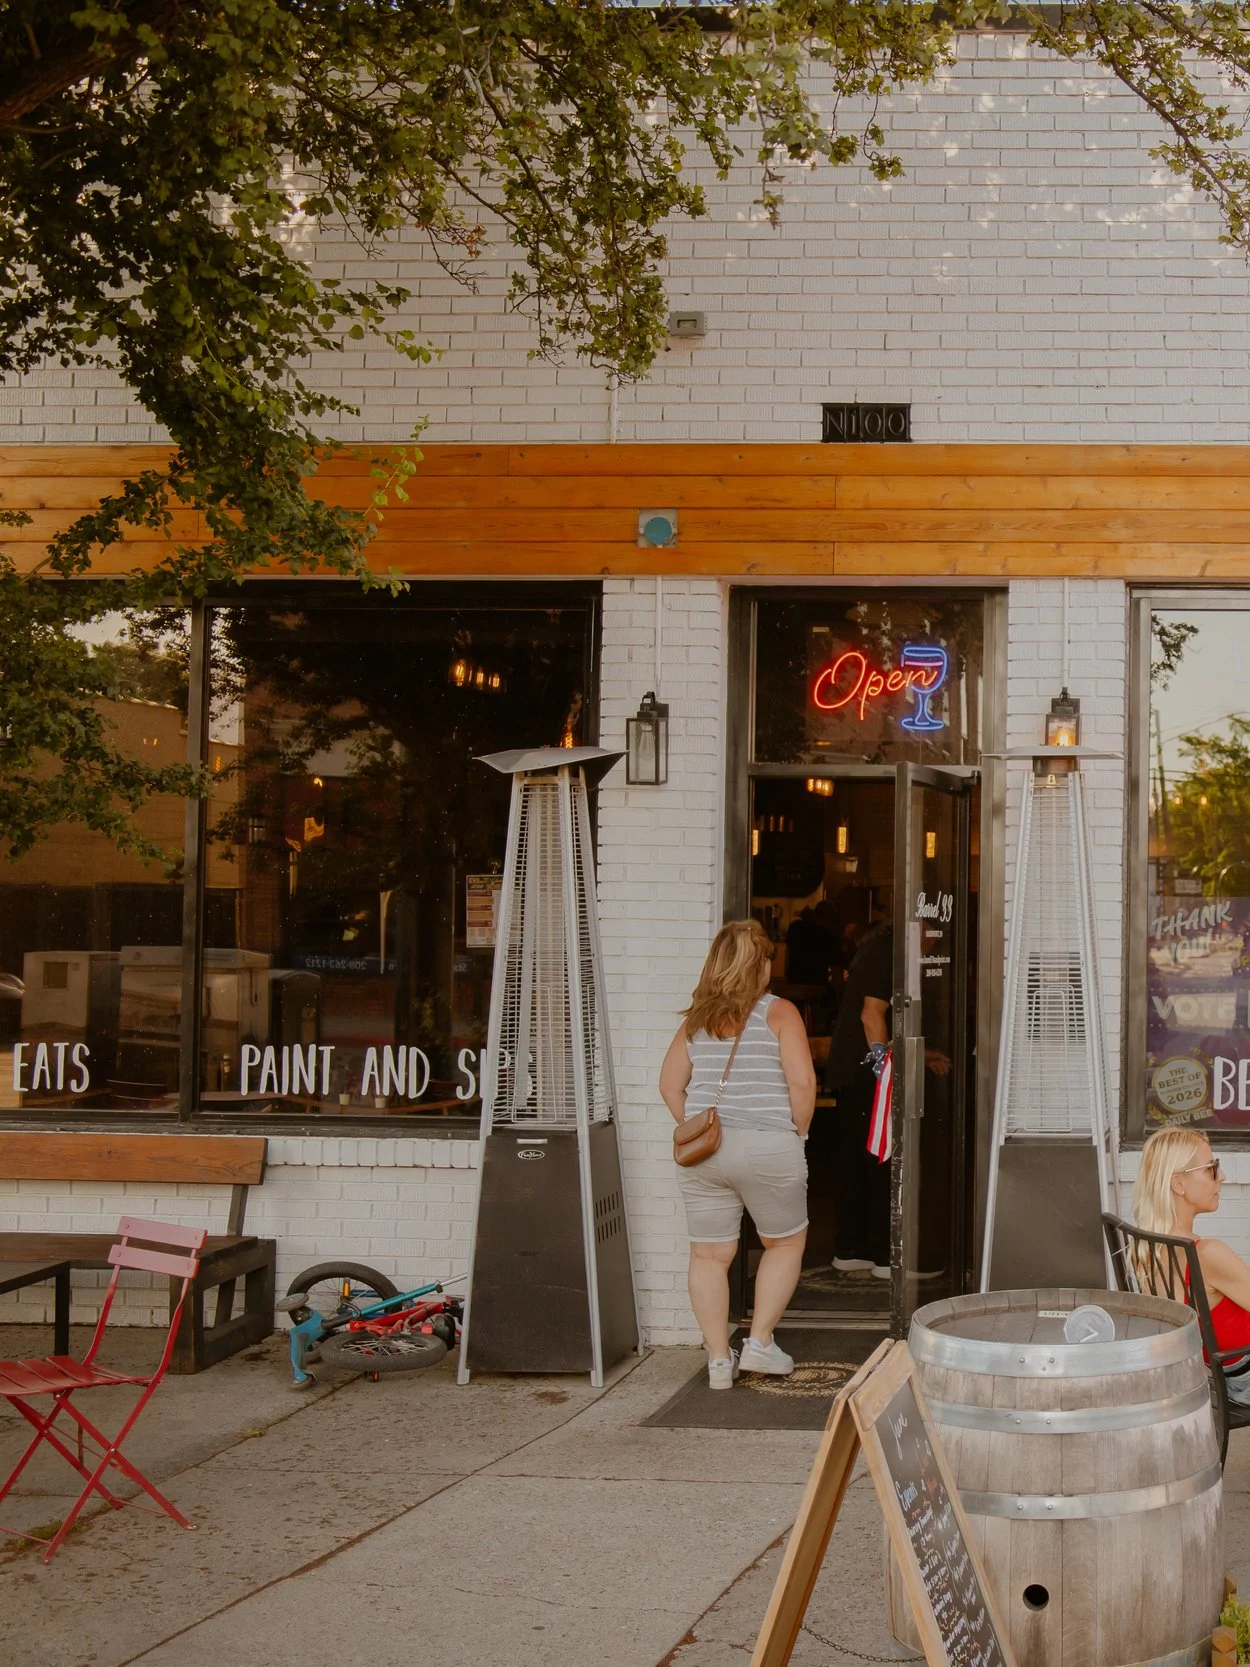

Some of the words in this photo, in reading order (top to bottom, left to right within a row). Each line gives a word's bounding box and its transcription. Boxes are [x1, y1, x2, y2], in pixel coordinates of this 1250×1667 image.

[812, 651, 939, 721] Open
[915, 891, 942, 918] Barrel
[939, 893, 954, 922] 33
[1151, 900, 1233, 940] THANK
[1151, 995, 1237, 1021] VOTE
[11, 1041, 91, 1093] EATS
[240, 1043, 335, 1096] PAINT
[360, 1045, 431, 1100] AND
[1158, 1075, 1185, 1089] BEST
[1187, 1071, 1201, 1082] OF
[1167, 1067, 1187, 1077] THE
[1167, 1088, 1202, 1105] 2026
[1164, 1111, 1191, 1127] DAILY
[1192, 1108, 1213, 1121] BEE
